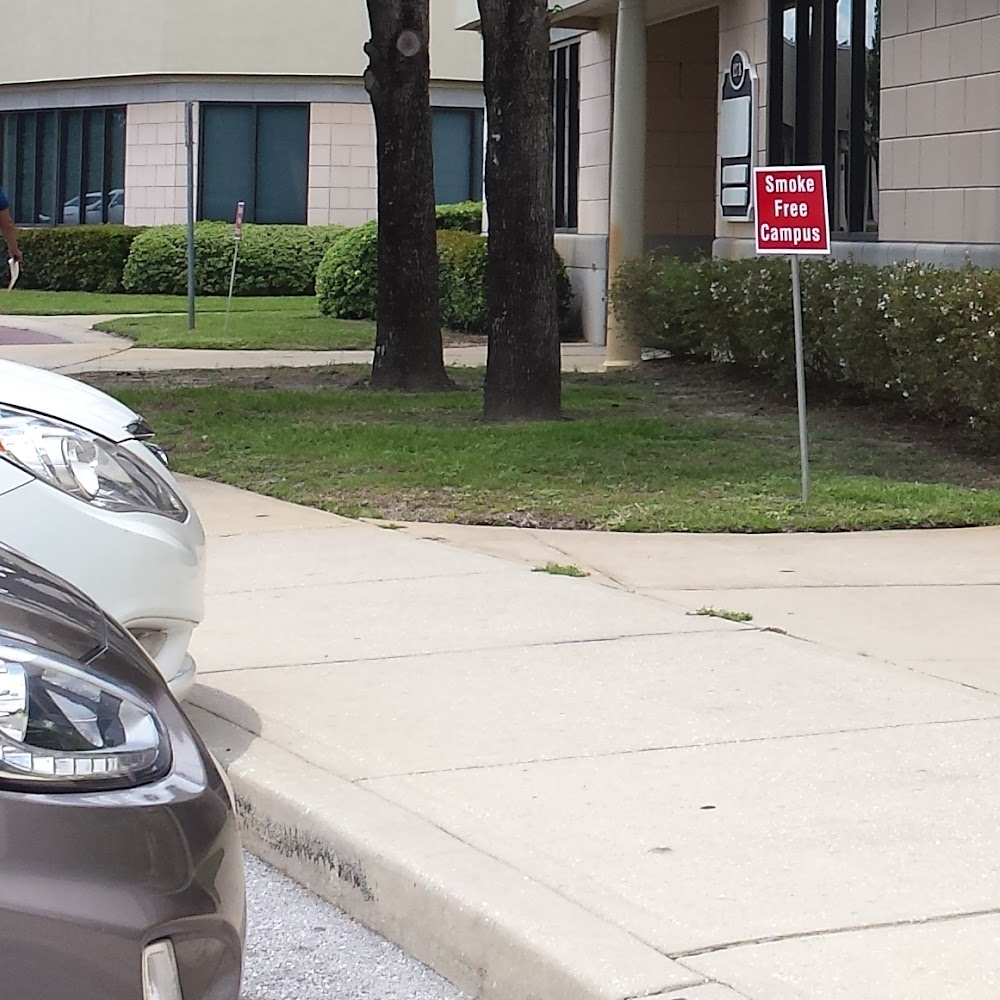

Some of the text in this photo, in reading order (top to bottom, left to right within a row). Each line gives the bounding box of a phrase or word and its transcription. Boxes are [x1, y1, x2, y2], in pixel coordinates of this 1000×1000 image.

[765, 175, 815, 193] Smoke
[774, 199, 808, 217] Free
[760, 223, 821, 246] Campus
